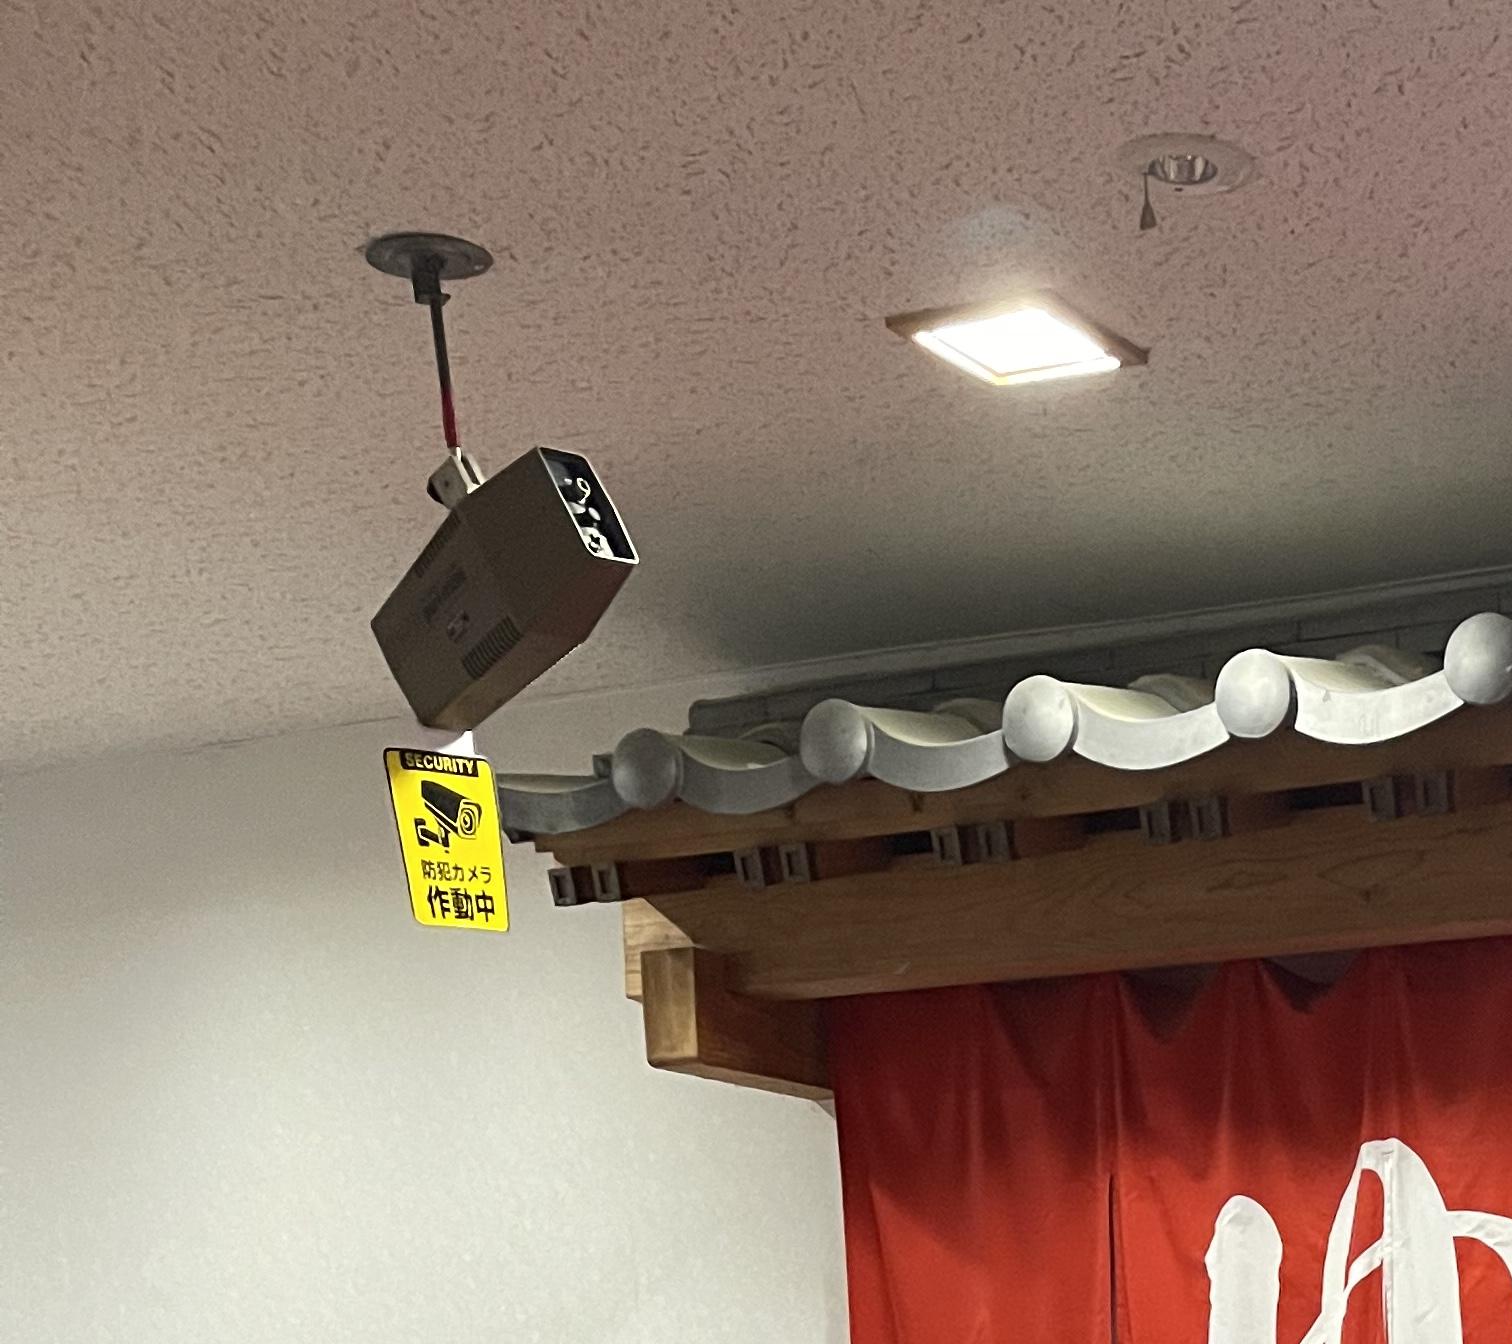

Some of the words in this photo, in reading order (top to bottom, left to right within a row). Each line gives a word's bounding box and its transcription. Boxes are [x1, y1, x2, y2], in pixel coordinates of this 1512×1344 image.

[405, 751, 475, 774] SECURITY
[421, 859, 493, 884] 防犯カメラ
[426, 885, 497, 923] 作動中
